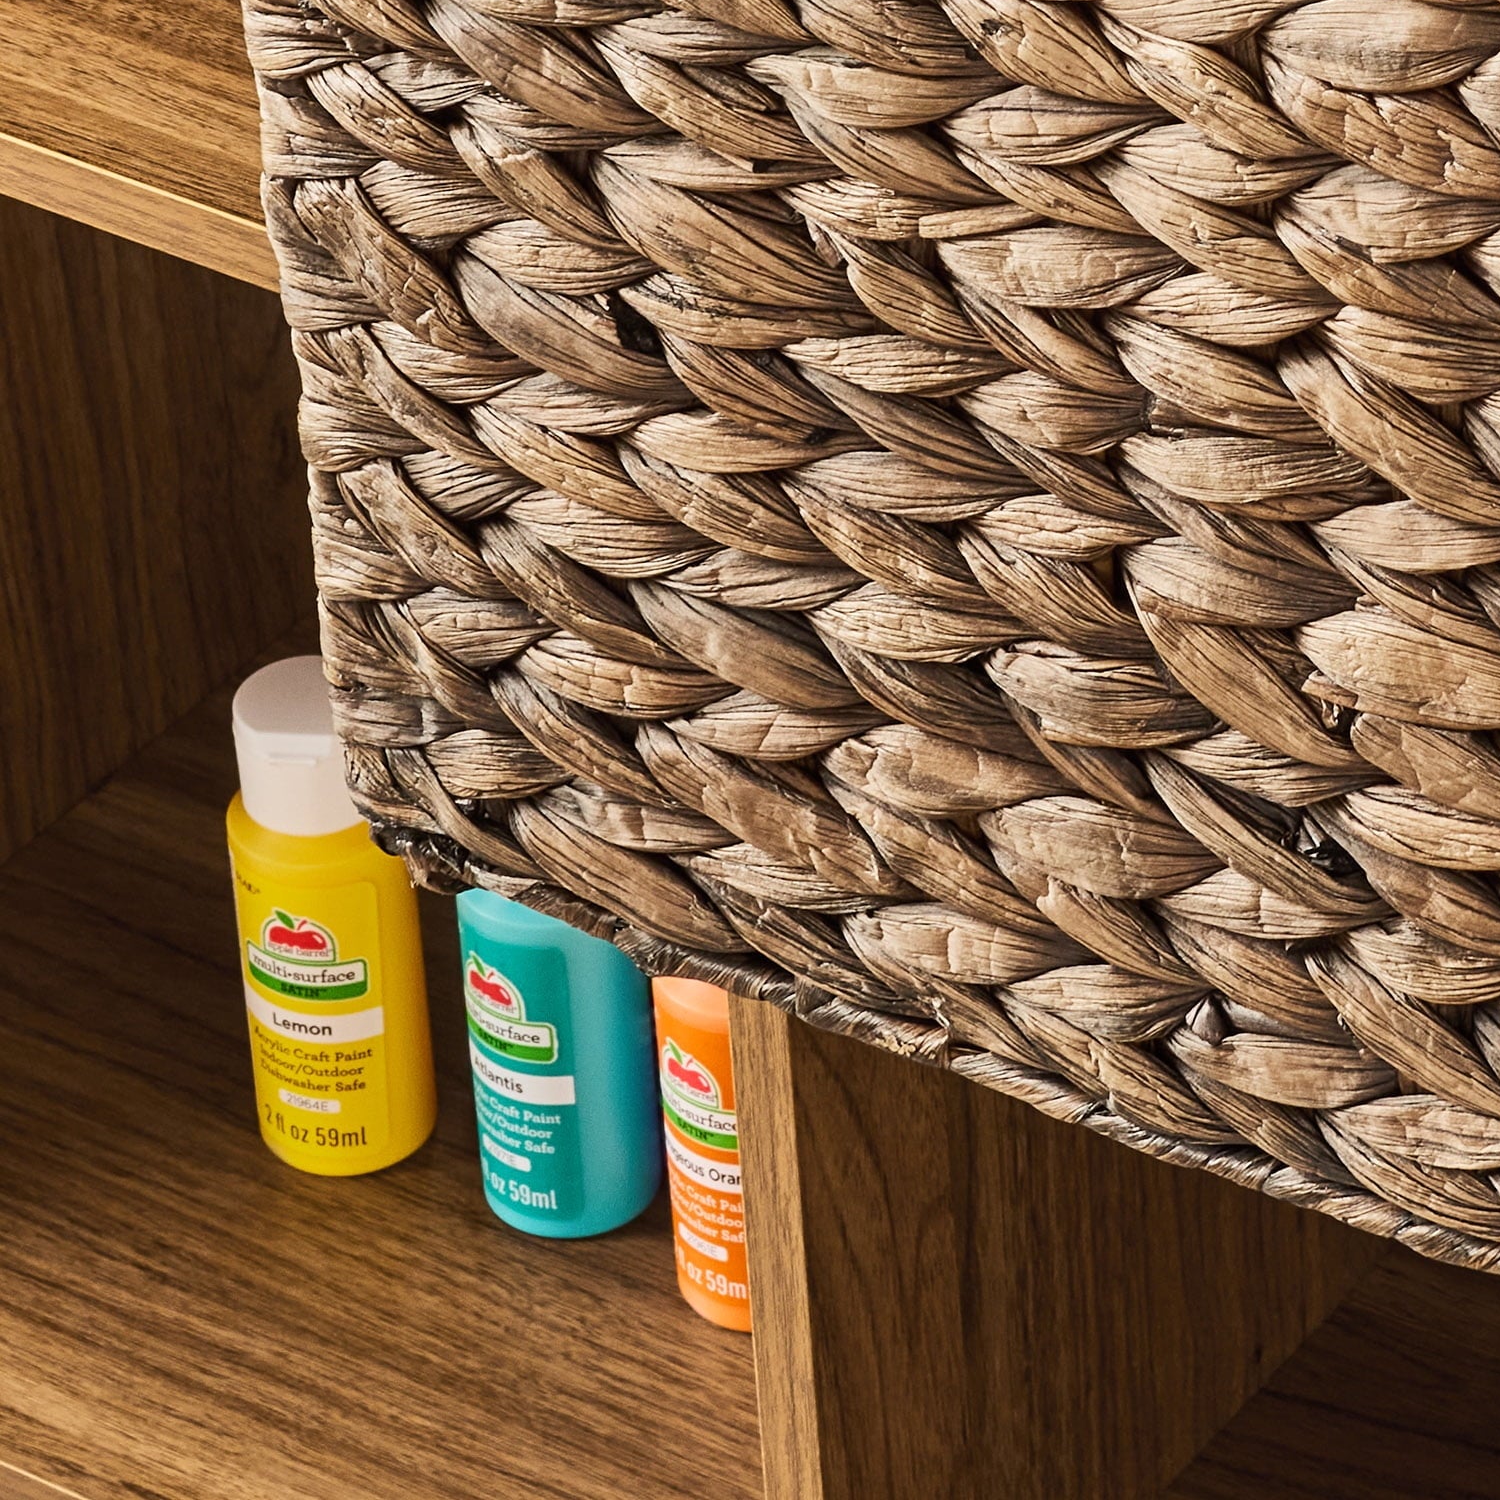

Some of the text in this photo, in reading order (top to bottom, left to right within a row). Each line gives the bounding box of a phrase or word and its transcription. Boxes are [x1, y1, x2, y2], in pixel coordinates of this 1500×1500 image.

[272, 1011, 333, 1037] Lemon
[293, 1048, 330, 1063] Craft
[335, 1048, 374, 1062] Paint
[335, 1080, 367, 1093] Safe
[264, 1103, 273, 1125] 2
[290, 1124, 310, 1144] oz
[315, 1125, 368, 1148] 59ml
[523, 1110, 561, 1125] Paint
[524, 1140, 556, 1155] Safe
[490, 1171, 506, 1196] oz
[508, 1179, 558, 1210] 59ml
[687, 1263, 703, 1286] oz
[705, 1269, 747, 1300] 59m
